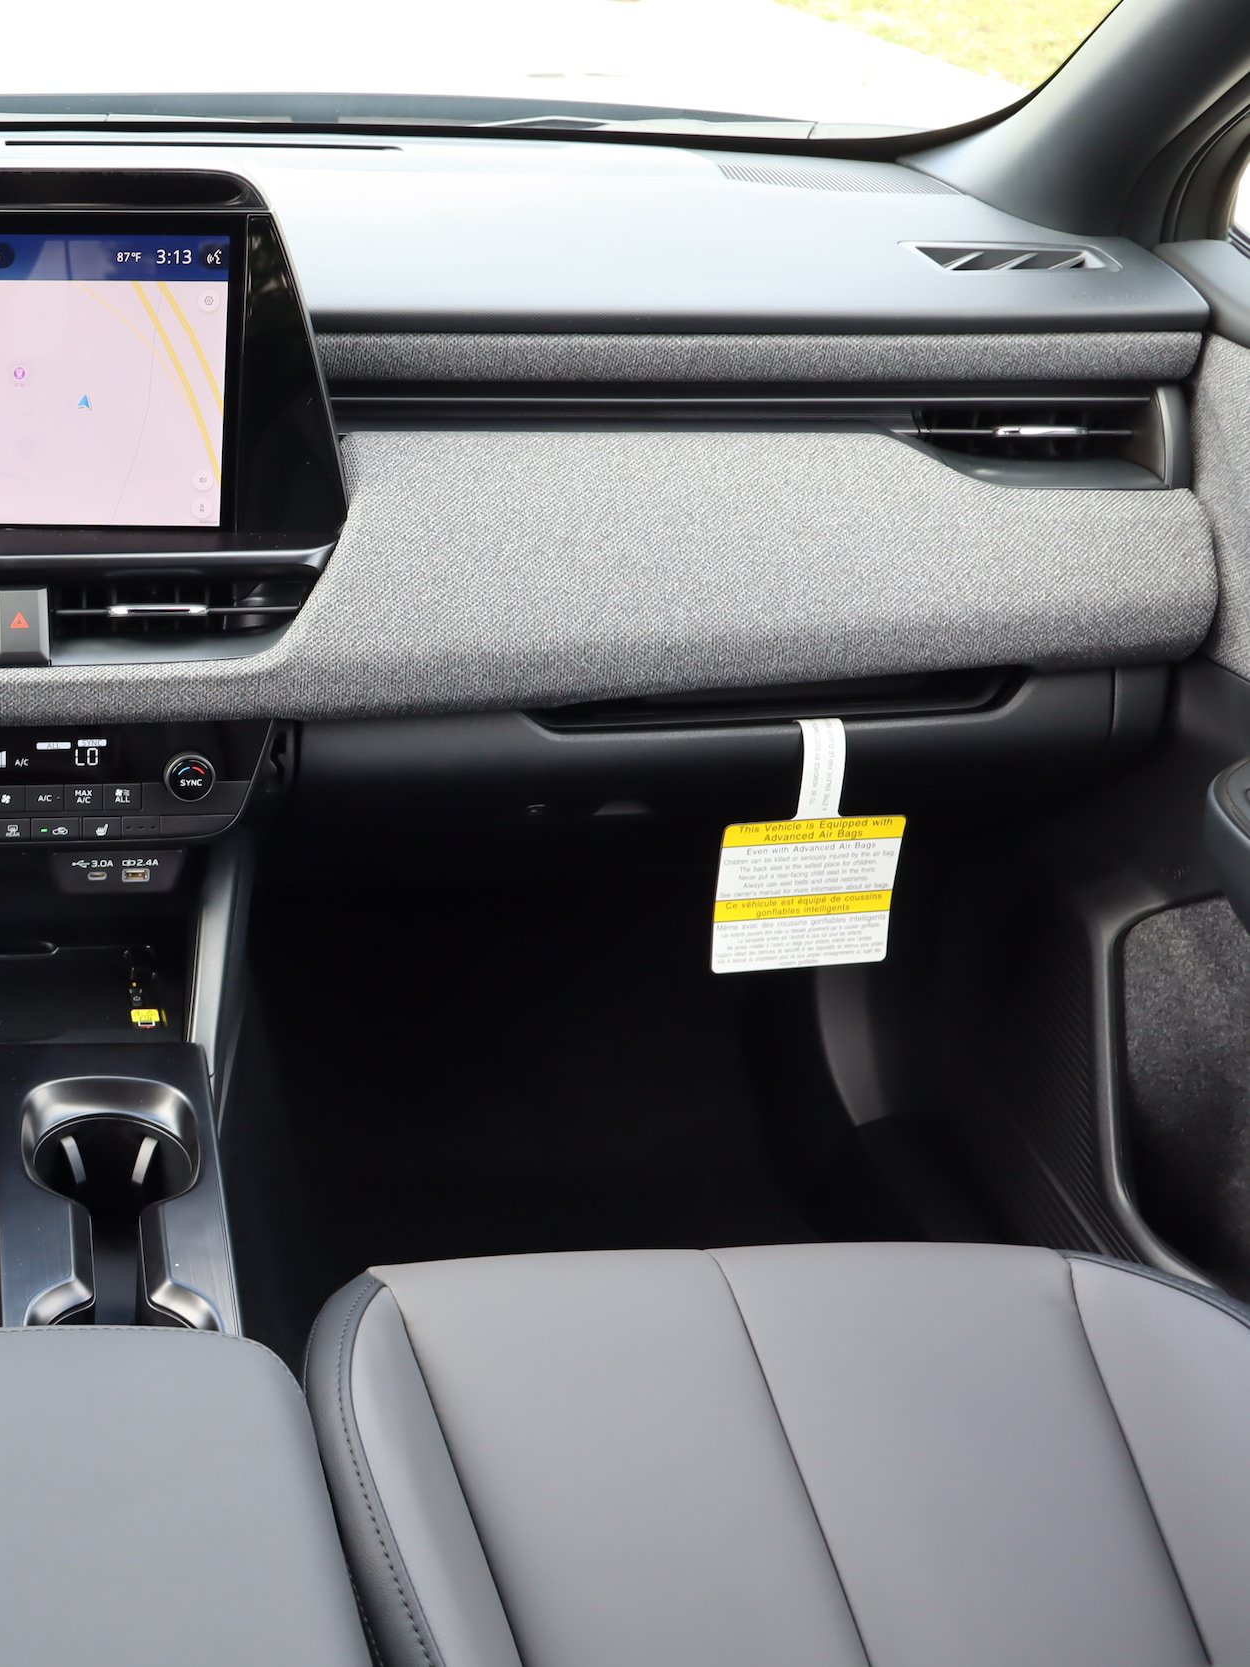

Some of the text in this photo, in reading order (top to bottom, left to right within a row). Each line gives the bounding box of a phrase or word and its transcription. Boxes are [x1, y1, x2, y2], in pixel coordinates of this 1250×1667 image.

[156, 250, 191, 264] 3:13
[15, 758, 28, 767] A/C
[75, 748, 98, 765] LO
[180, 779, 202, 787] SYNC
[38, 794, 52, 802] A/C
[765, 823, 802, 832] Vehicle
[819, 819, 868, 829] Equipped
[872, 818, 893, 826] with
[763, 829, 863, 842] Advanced Air Bags
[746, 848, 768, 856] Even
[772, 846, 789, 854] with
[793, 843, 835, 852] Advanced
[855, 842, 876, 850] Bags
[91, 860, 114, 868] 3.0A
[725, 902, 738, 910] Ce
[742, 900, 777, 909] véhicule
[798, 896, 827, 905] équipé
[844, 893, 882, 902] coussins
[756, 904, 850, 918] gonflables intelligents
[810, 916, 847, 925] gonflables
[849, 913, 886, 922] intelligents
